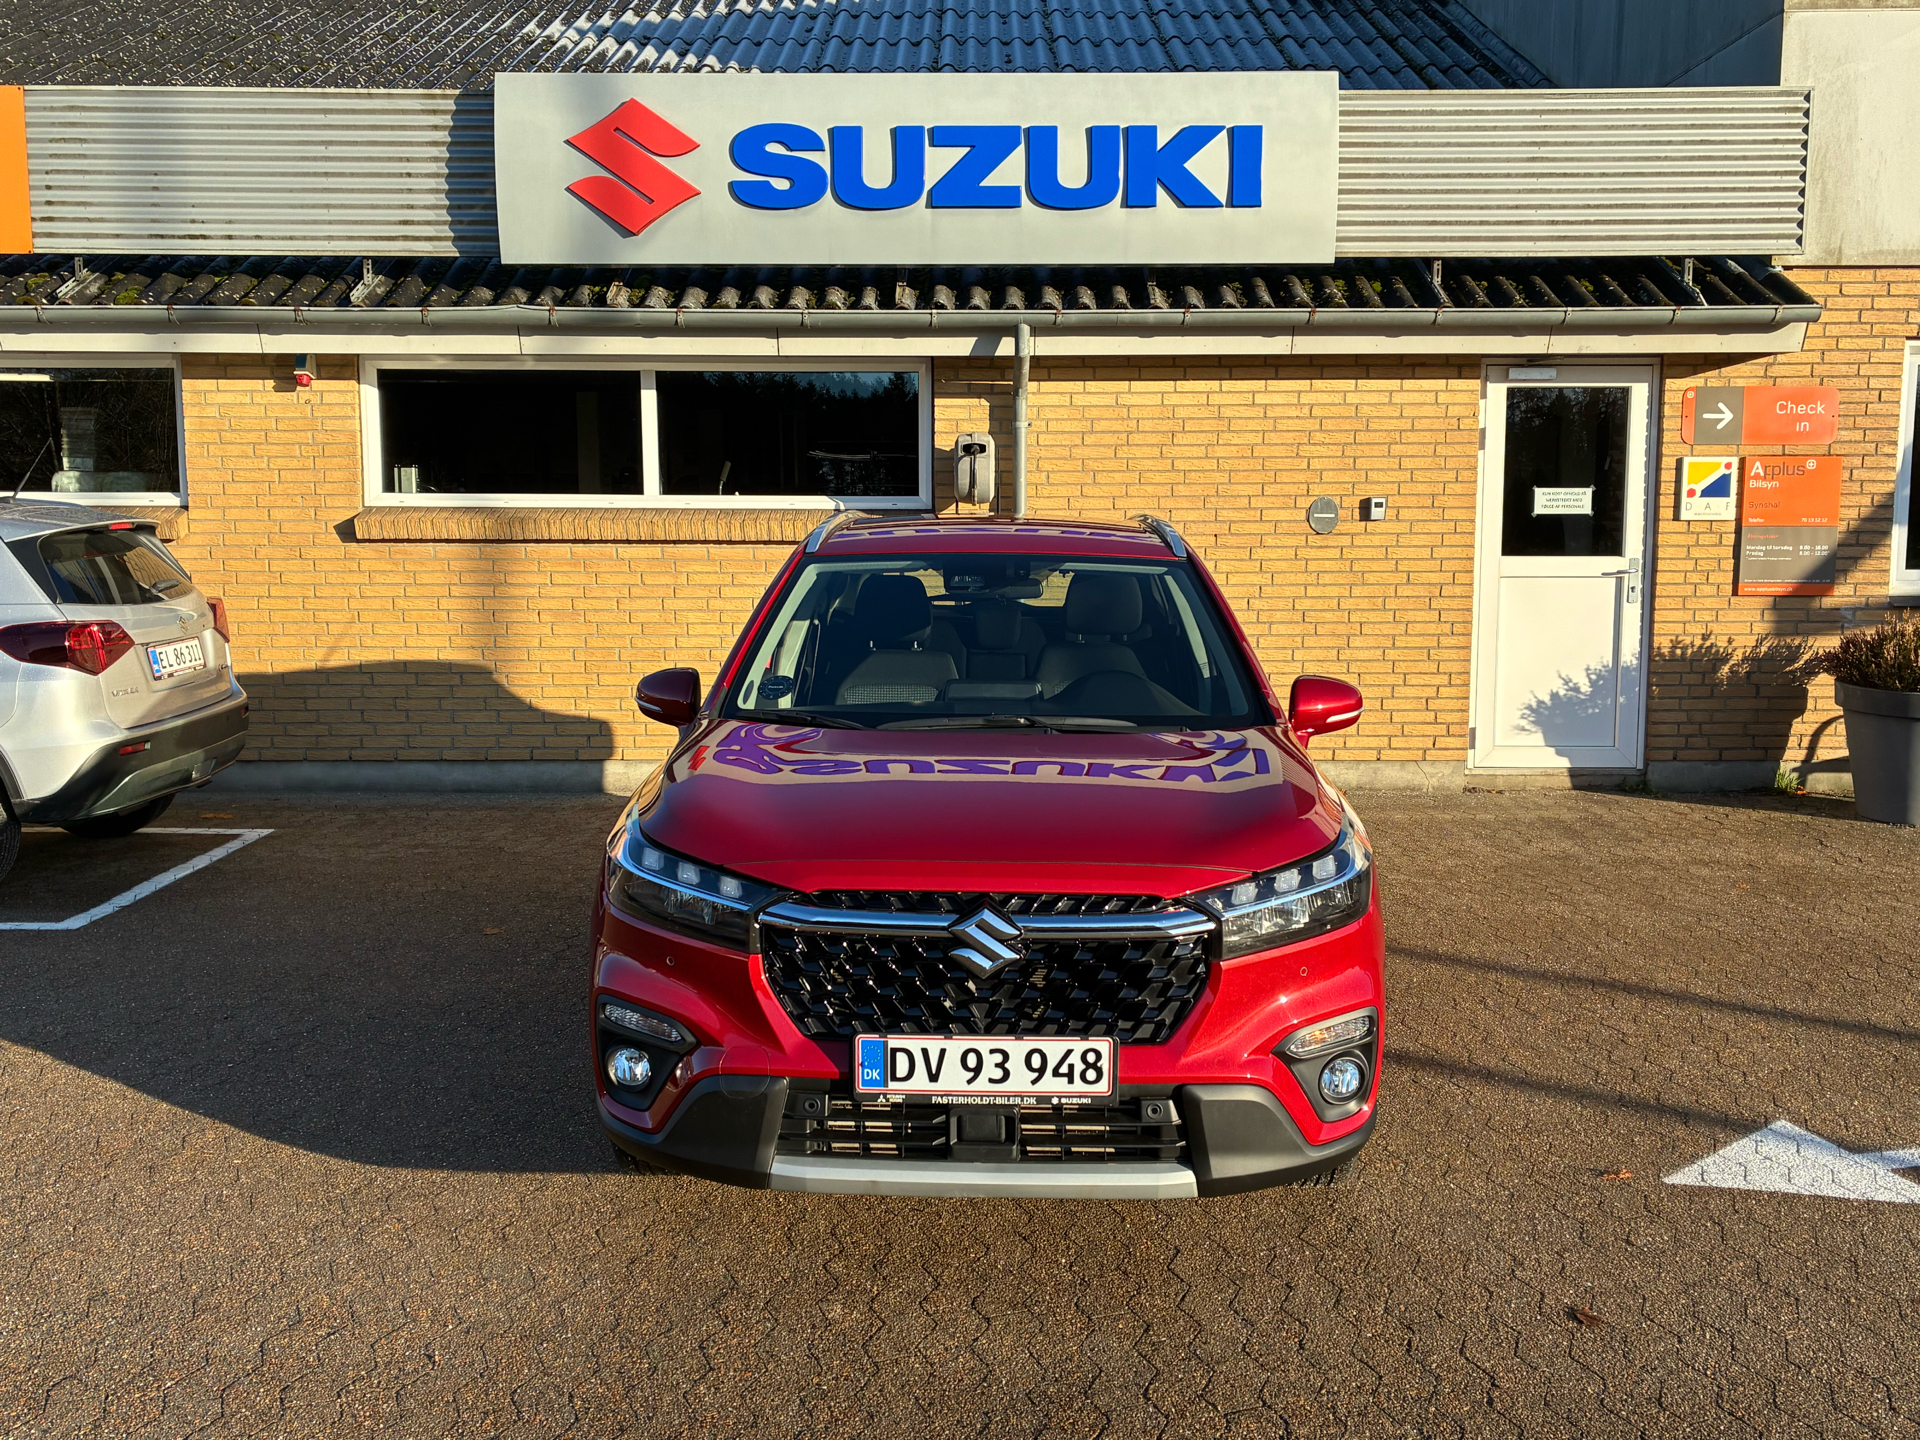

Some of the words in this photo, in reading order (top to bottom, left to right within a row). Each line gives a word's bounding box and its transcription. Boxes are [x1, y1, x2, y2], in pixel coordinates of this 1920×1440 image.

[729, 122, 1263, 210] SUZUKI
[1776, 401, 1826, 414] Check
[1796, 421, 1810, 433] in
[1750, 461, 1806, 480] Applus
[1749, 479, 1780, 490] Bilsyn
[158, 650, 174, 670] EL
[173, 646, 186, 666] 86
[185, 644, 202, 663] 311
[863, 1068, 881, 1081] DK
[890, 1047, 946, 1083] DV
[960, 1047, 1011, 1085] 93
[1024, 1047, 1104, 1085] 948
